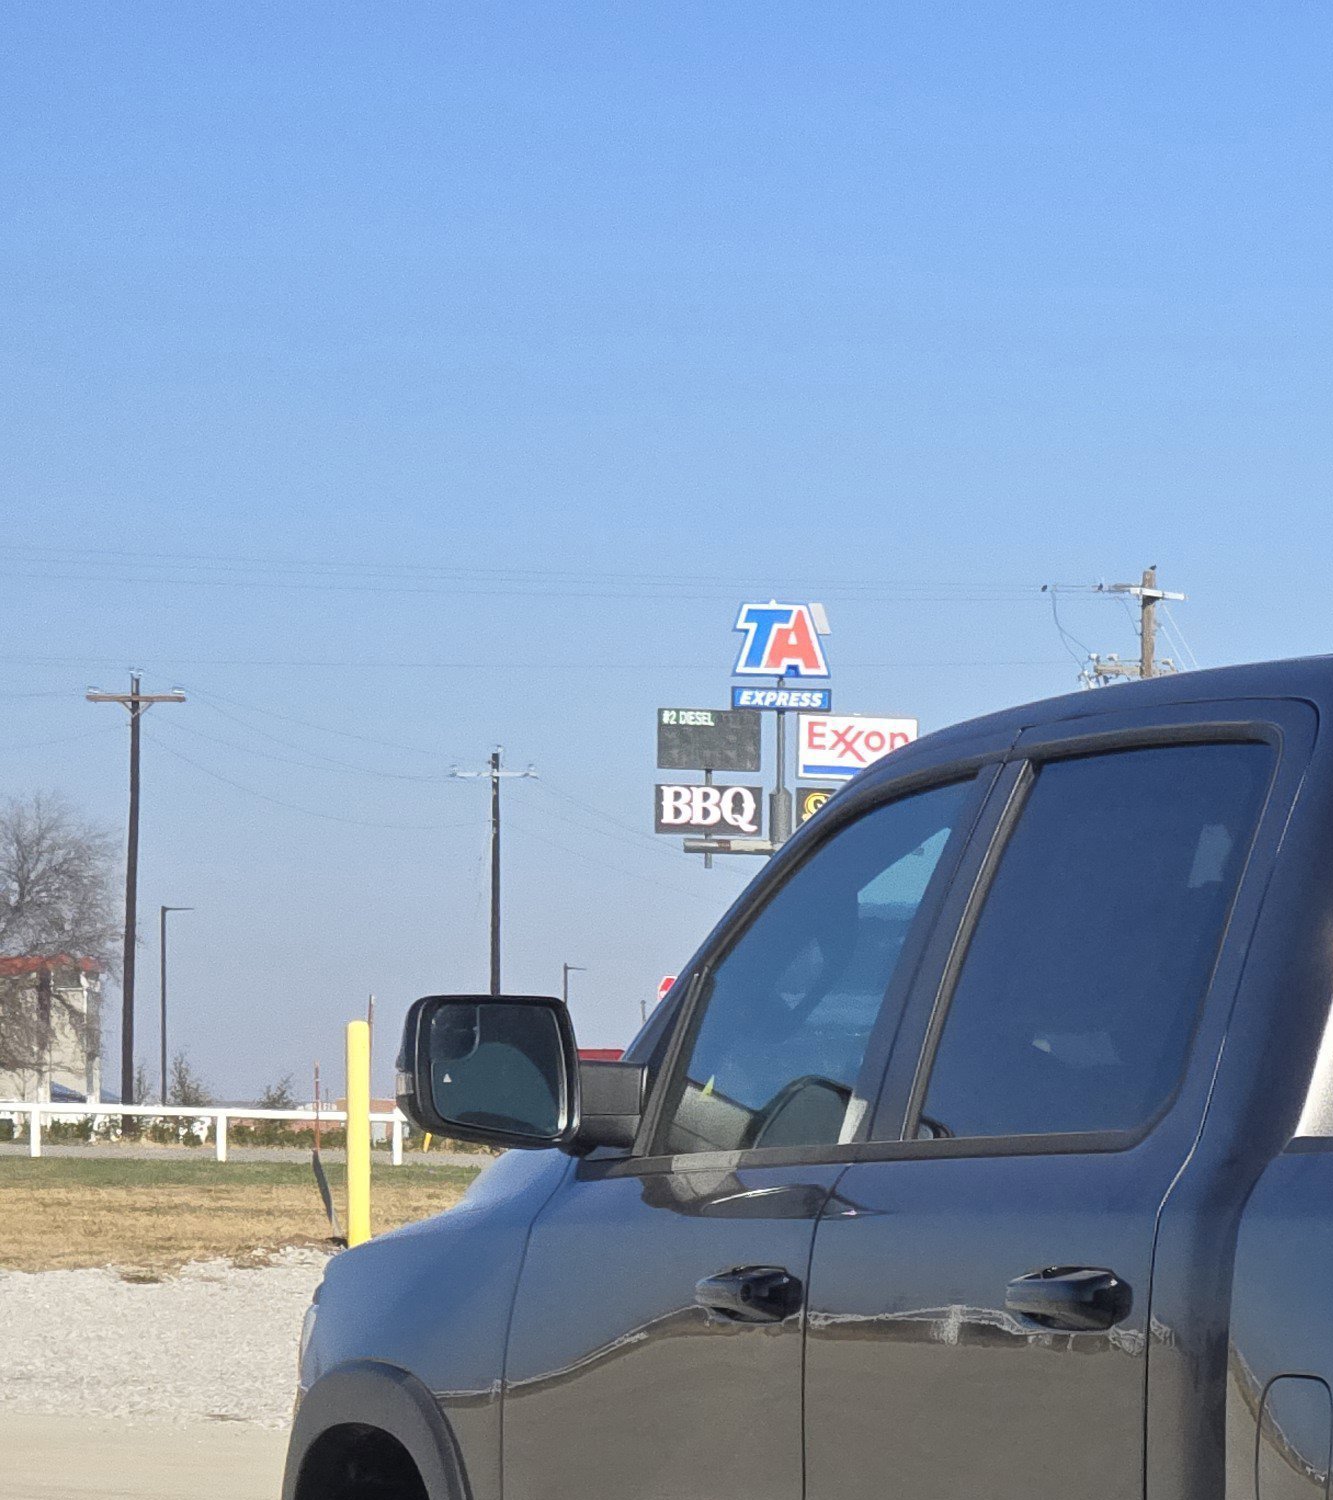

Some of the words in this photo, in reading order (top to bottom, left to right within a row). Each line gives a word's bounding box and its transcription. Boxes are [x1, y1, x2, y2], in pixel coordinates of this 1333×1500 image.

[743, 607, 822, 669] TA
[739, 690, 823, 708] EXPRESS
[679, 711, 715, 727] DIESEL
[660, 785, 758, 832] BBQ
